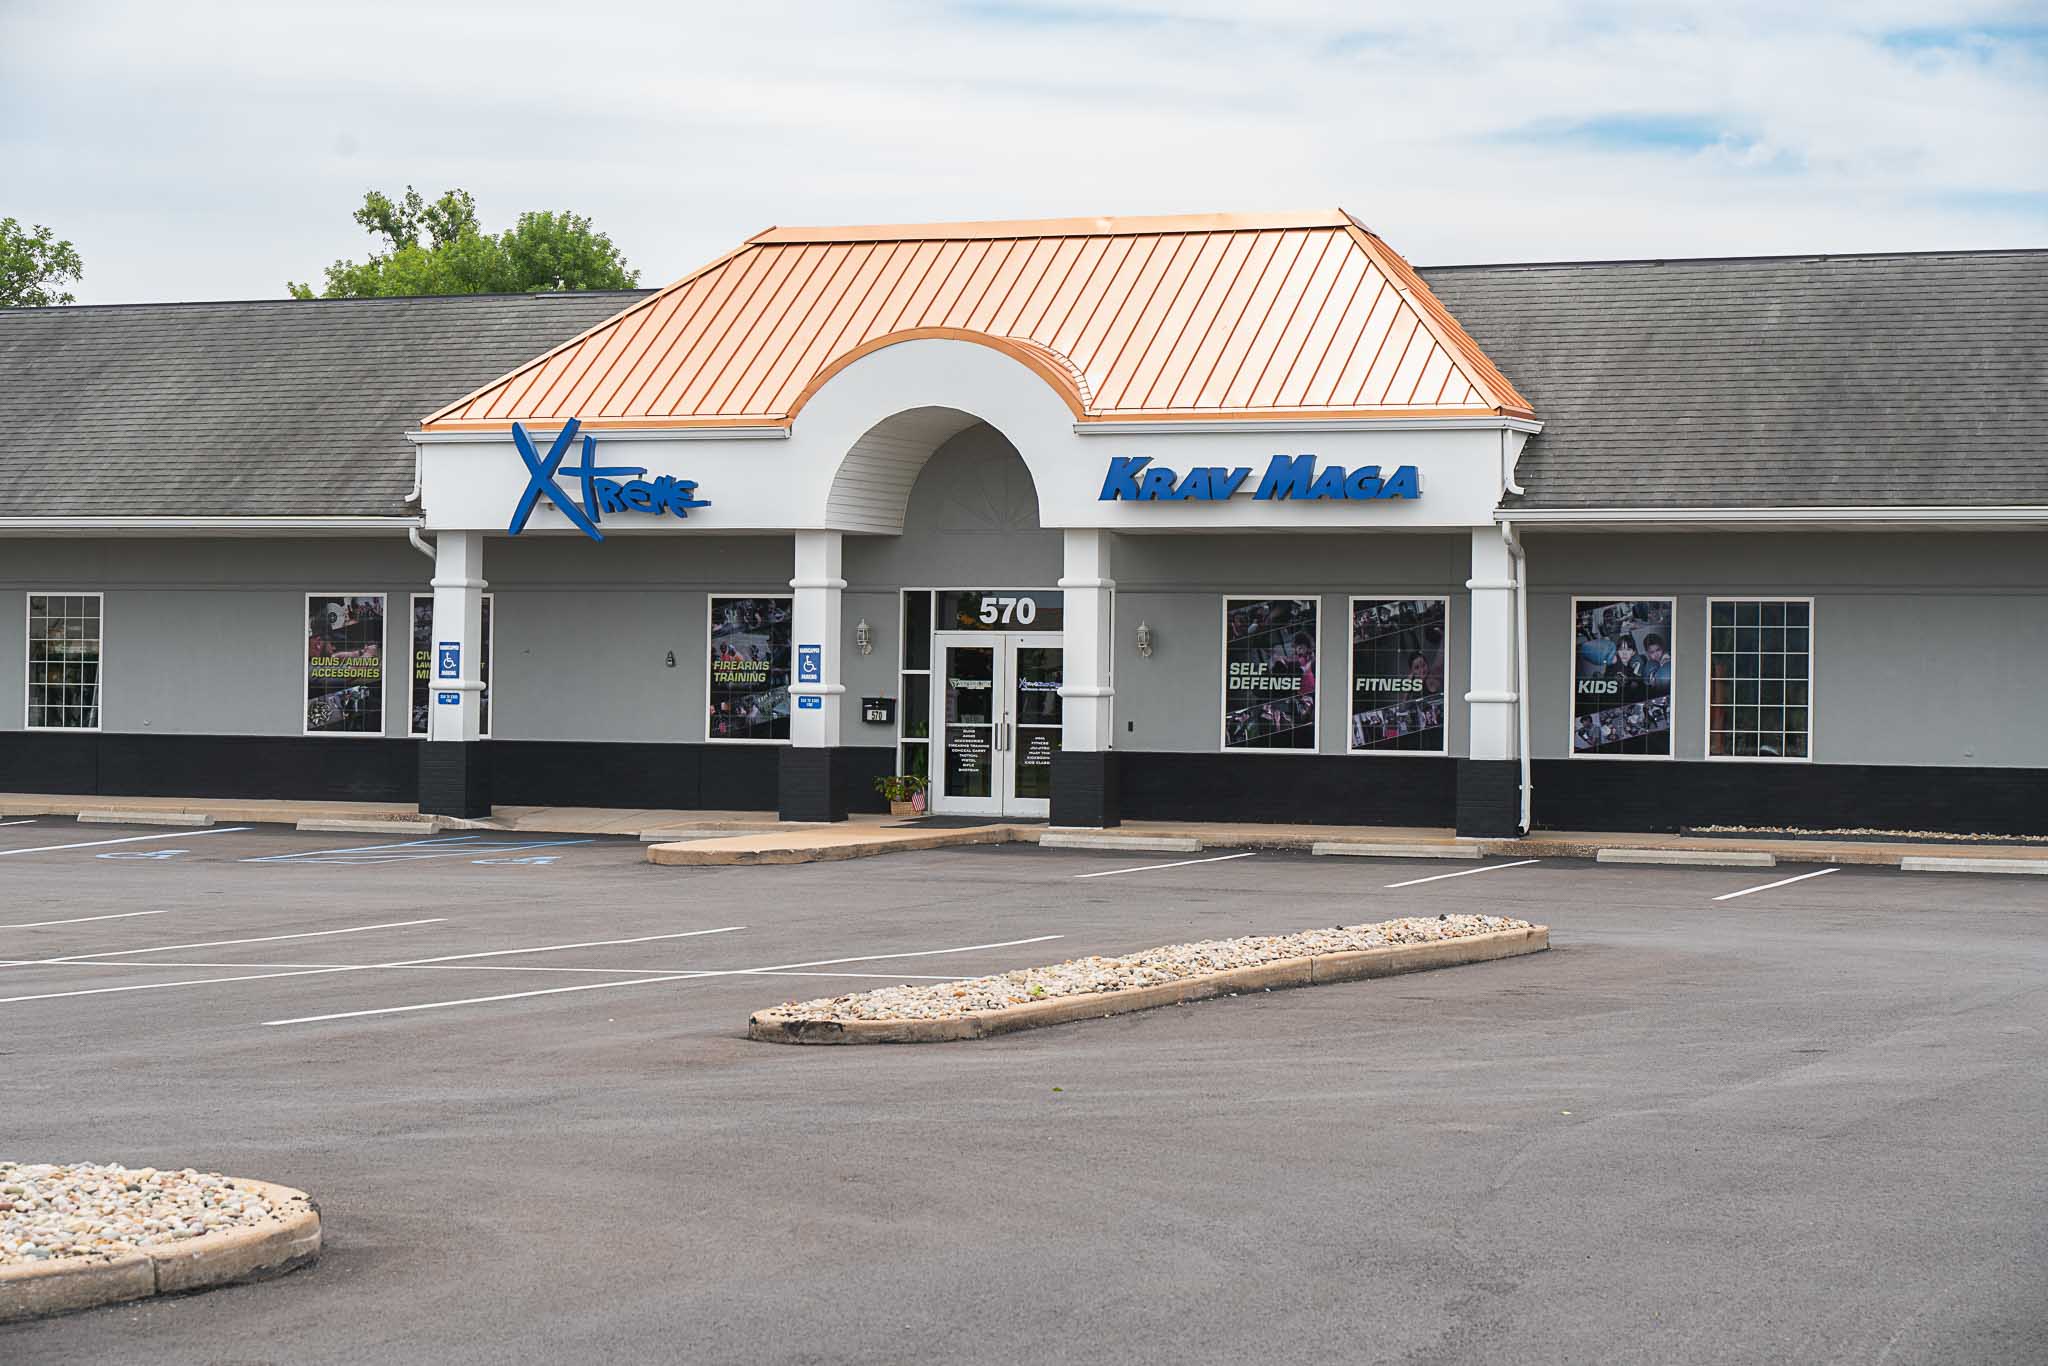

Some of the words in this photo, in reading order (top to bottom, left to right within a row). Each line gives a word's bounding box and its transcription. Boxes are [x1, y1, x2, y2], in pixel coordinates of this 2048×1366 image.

[979, 597, 1036, 625] 570
[713, 660, 770, 671] FIREARMS
[1229, 662, 1268, 676] SELF
[311, 668, 380, 678] ACCESSORIES
[713, 672, 767, 683] TRAINING
[1229, 676, 1301, 690] DEFENSE
[1355, 678, 1423, 692] FITNESS
[1578, 680, 1618, 694] KIDS
[871, 710, 883, 721] 570
